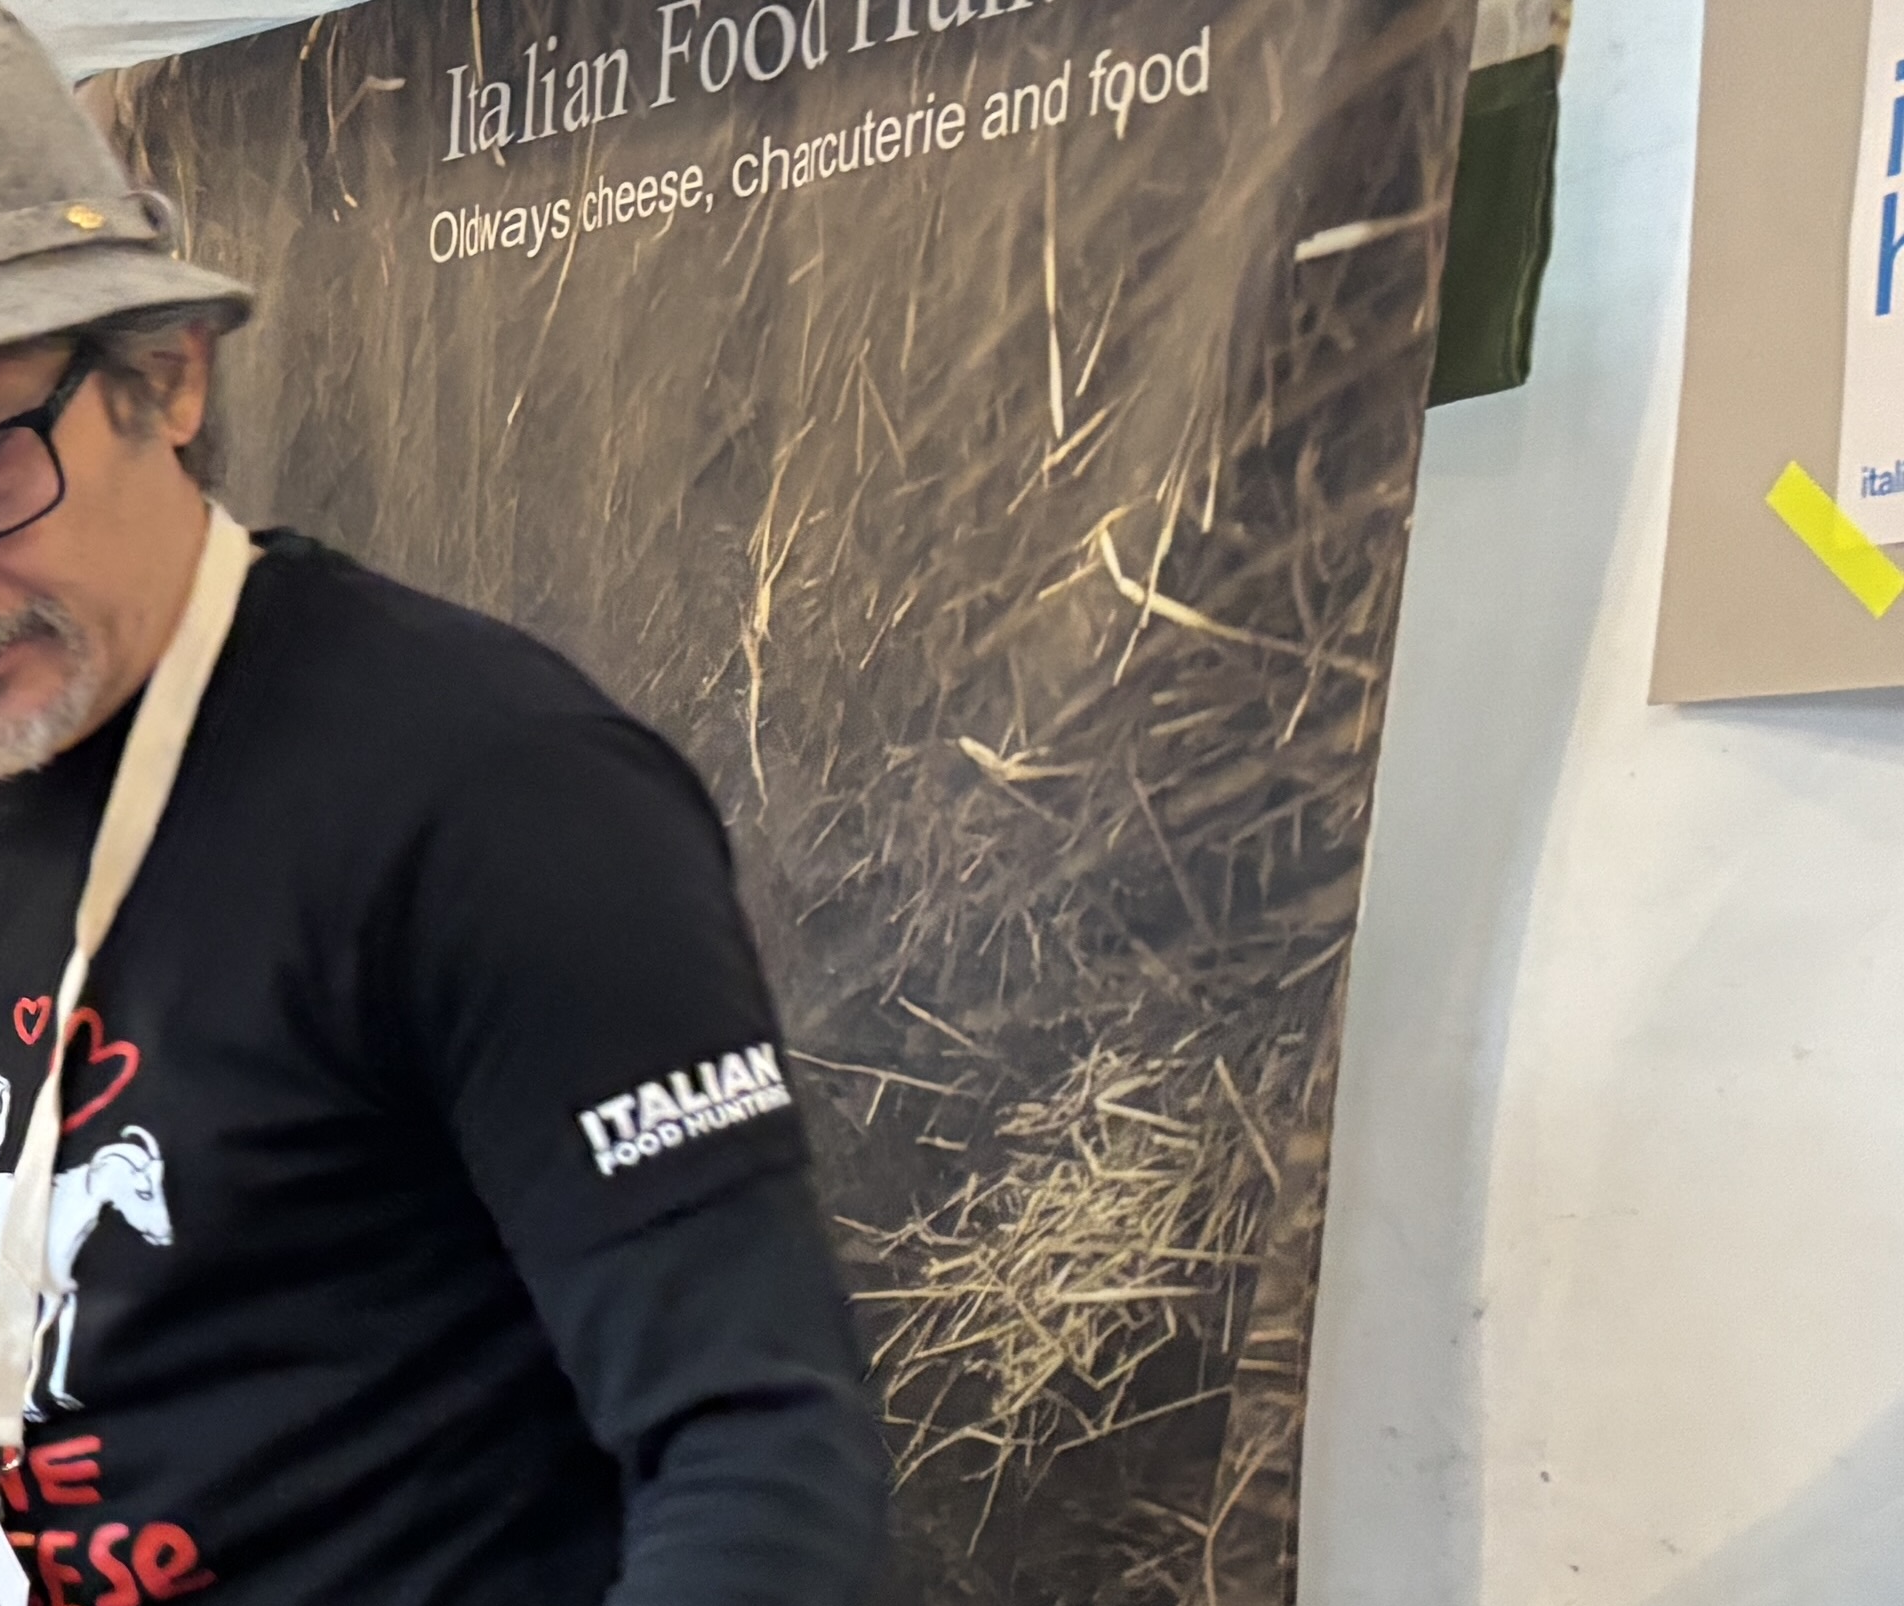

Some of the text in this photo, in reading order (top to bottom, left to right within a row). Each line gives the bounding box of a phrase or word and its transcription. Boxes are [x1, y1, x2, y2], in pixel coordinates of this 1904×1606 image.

[430, 27, 1209, 266] Oldways cheese, charcuterie and food
[441, 37, 631, 164] Italian
[650, 0, 830, 108] Food
[578, 1042, 784, 1153] ITALIAN
[595, 1121, 684, 1177] FOOD
